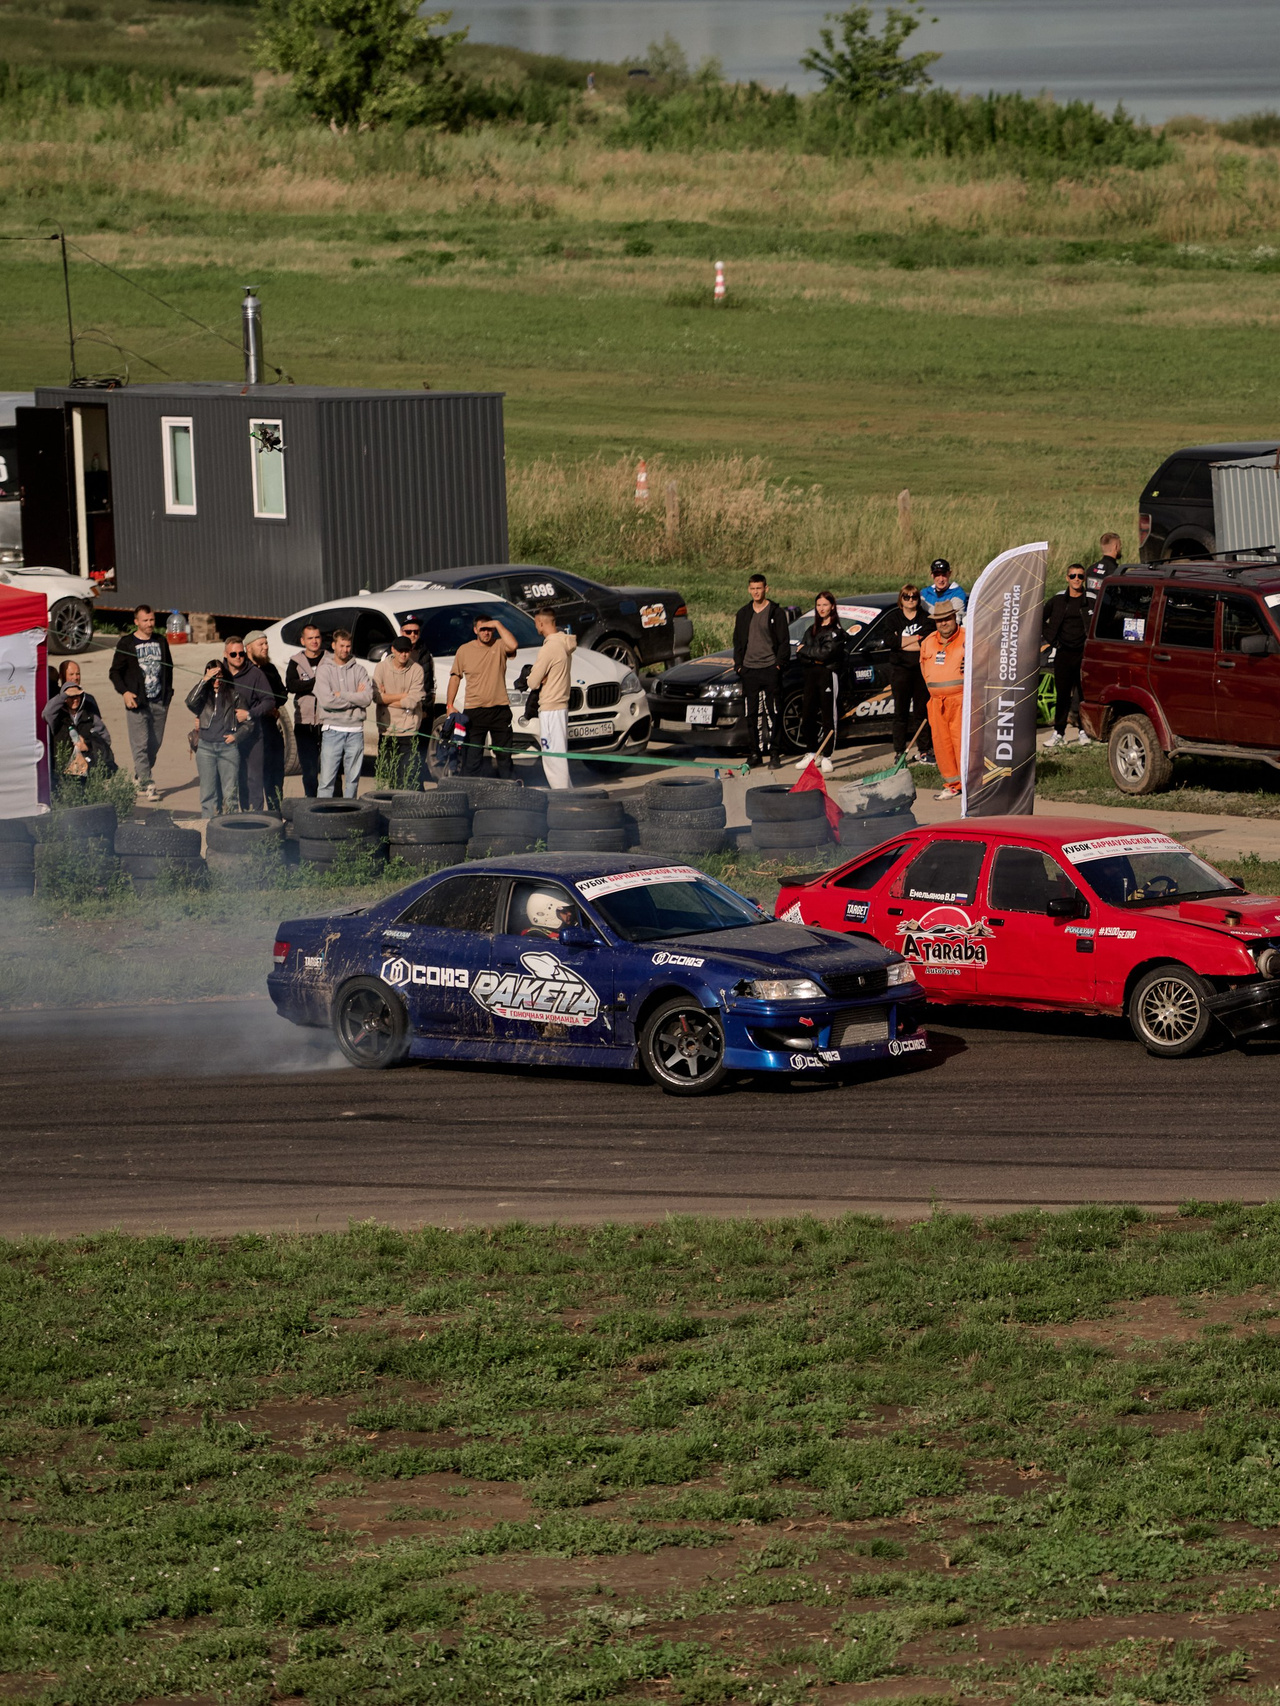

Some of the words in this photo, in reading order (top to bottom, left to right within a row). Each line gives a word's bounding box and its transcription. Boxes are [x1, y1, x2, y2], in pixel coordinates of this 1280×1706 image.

[531, 583, 555, 598] 096
[1000, 591, 1012, 681] СОВРЕМЕННАЯ
[1009, 584, 1021, 682] СТОМАТОЛОГИЯ
[1063, 843, 1092, 855] КУБОК
[1090, 836, 1153, 849] БАРНАУЛЬСКОЙ
[578, 877, 609, 891] КУБОК
[607, 868, 673, 882] БАРНАУЛЬСКОЙ
[909, 888, 945, 901] Емельянов
[846, 904, 869, 916] TARGET
[668, 955, 705, 968] СОЮЗ
[412, 964, 469, 989] СОЮЗ
[925, 966, 961, 976] AutoParts
[473, 971, 596, 1015] РАКЕТА
[510, 1010, 544, 1021] ГОНОЧНАЯ
[545, 1014, 580, 1024] КОМАНДА
[902, 1038, 927, 1052] СОЮЗ
